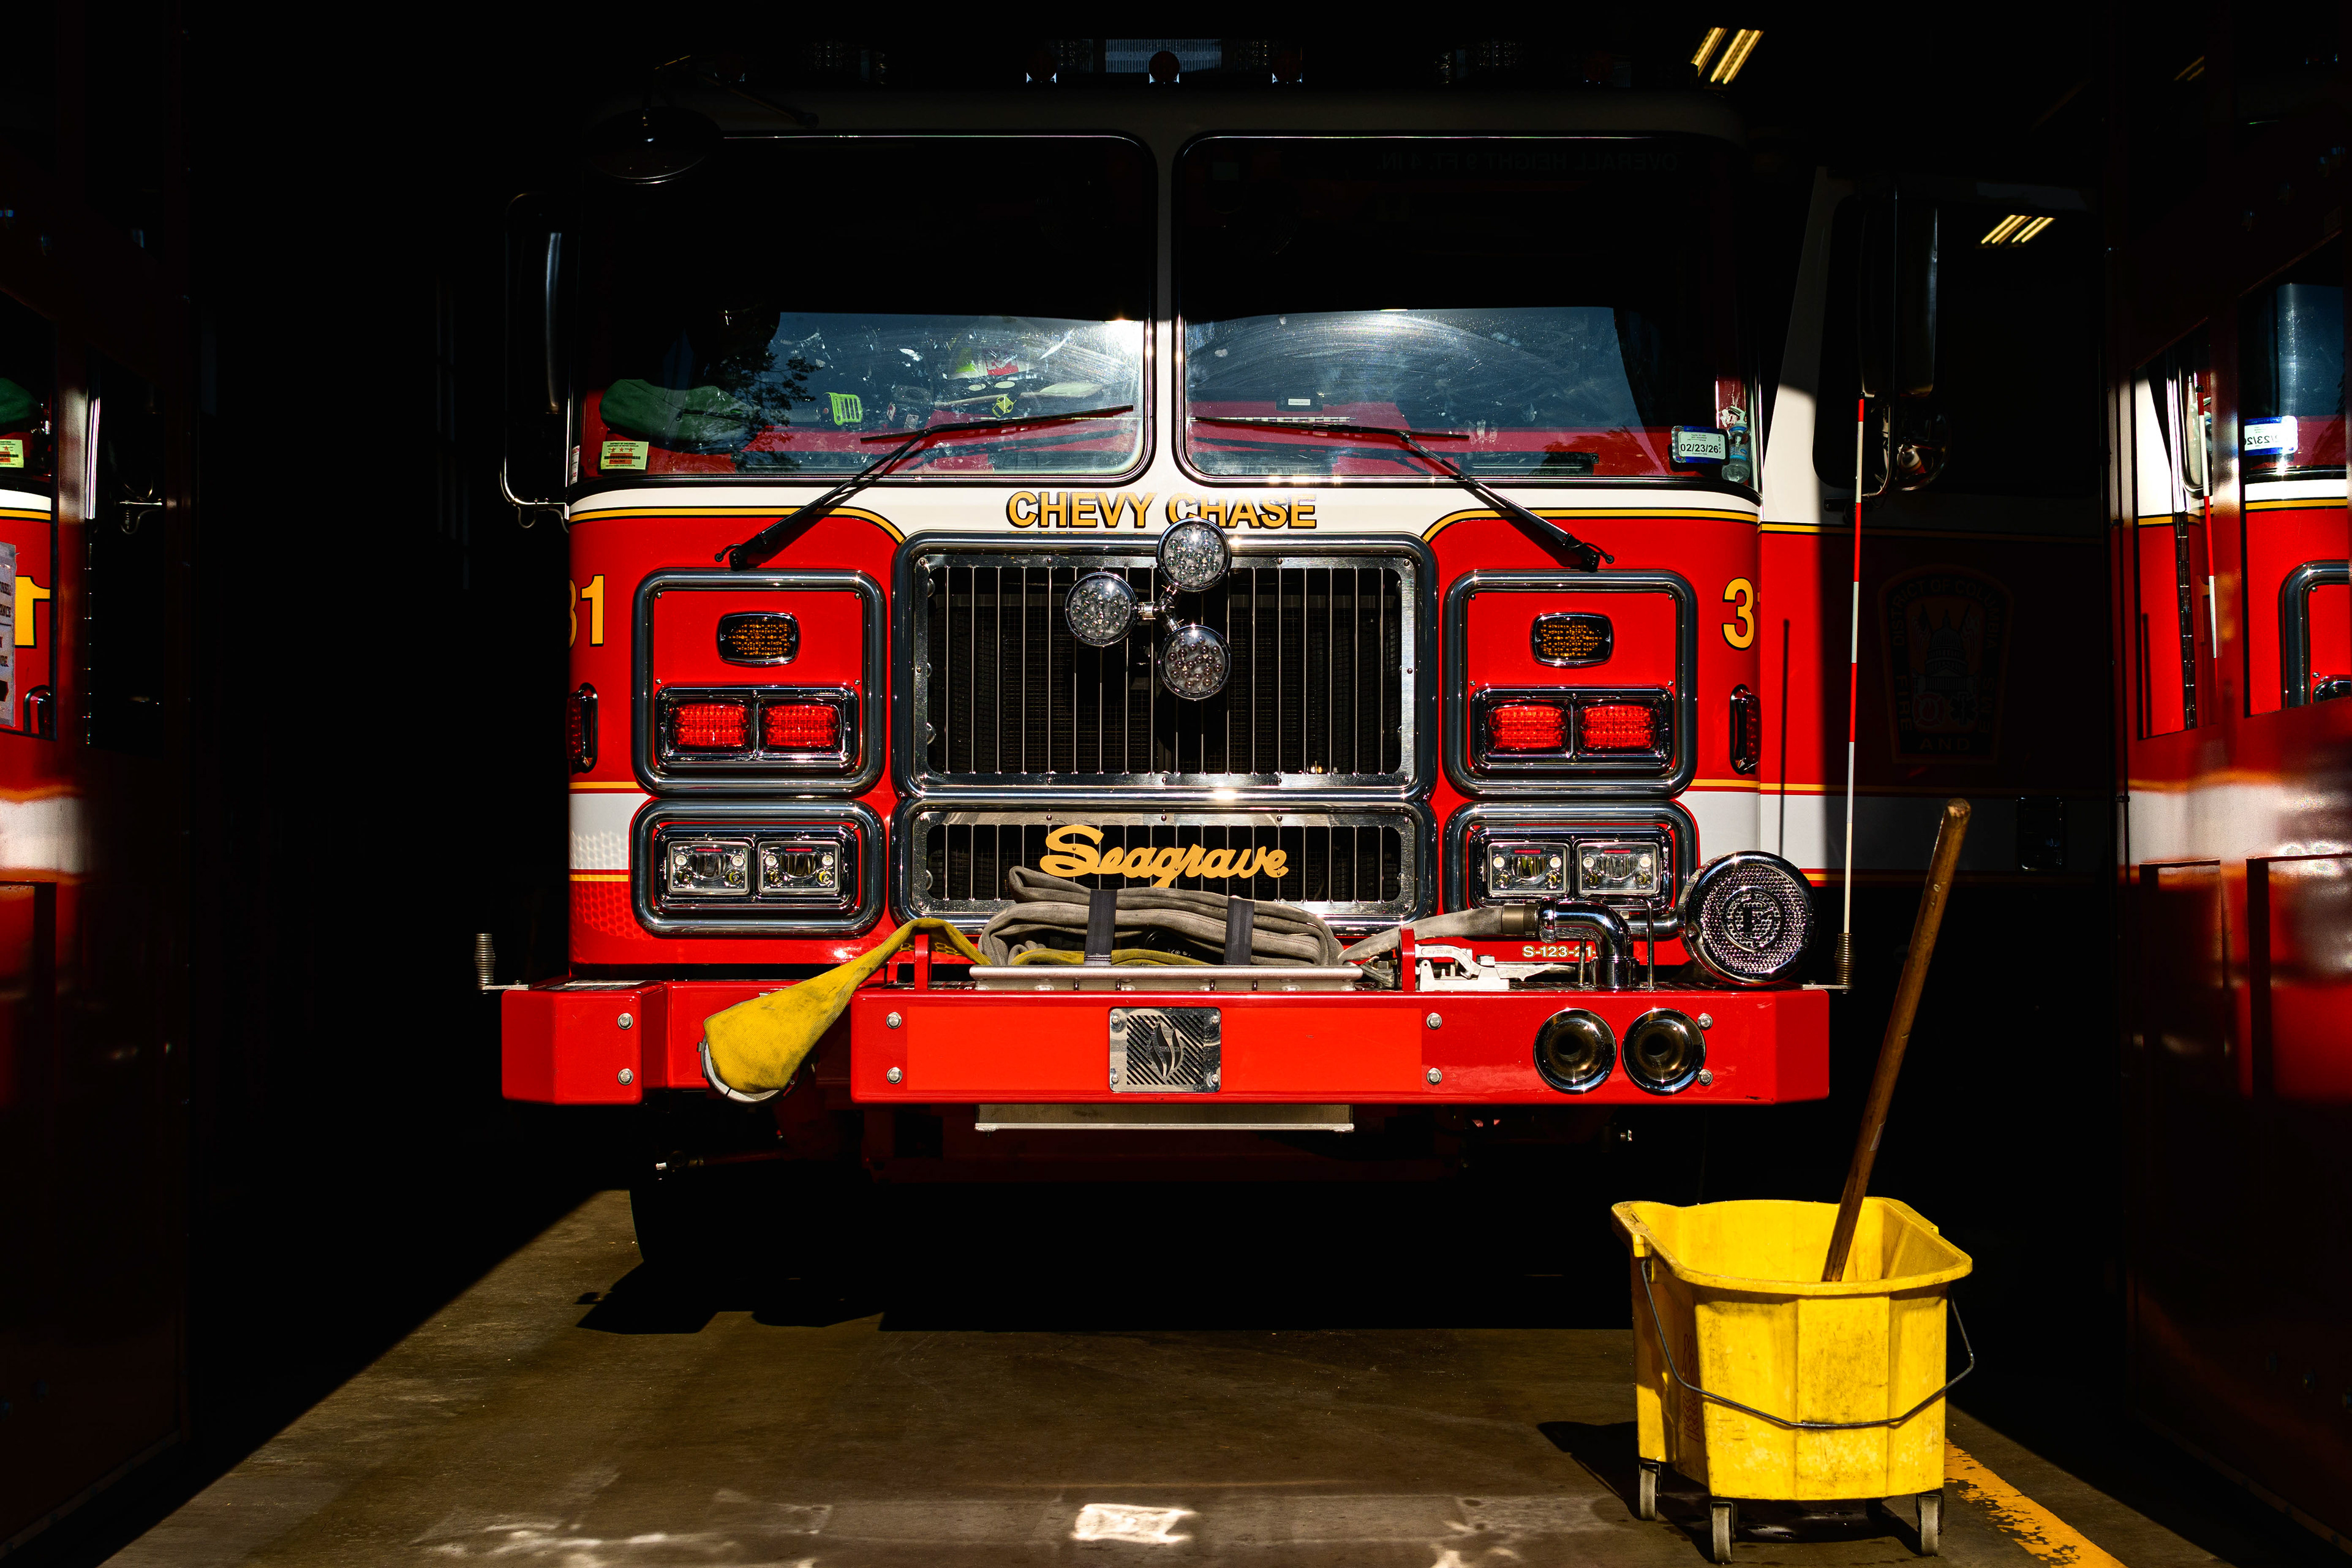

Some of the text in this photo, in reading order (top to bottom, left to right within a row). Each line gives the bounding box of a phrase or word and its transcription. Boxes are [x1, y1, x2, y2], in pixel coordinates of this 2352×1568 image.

[1680, 443, 1719, 453] 02/23/26
[1006, 491, 1317, 529] CHEVY CHASE
[1722, 577, 1761, 651] 3
[1891, 578, 2000, 650] DISTRICT OF COLUMBIA
[1896, 674, 1913, 731] FIRE
[1978, 676, 1995, 734] EMS
[1919, 737, 1970, 752] AND
[1039, 824, 1289, 888] Seagrave
